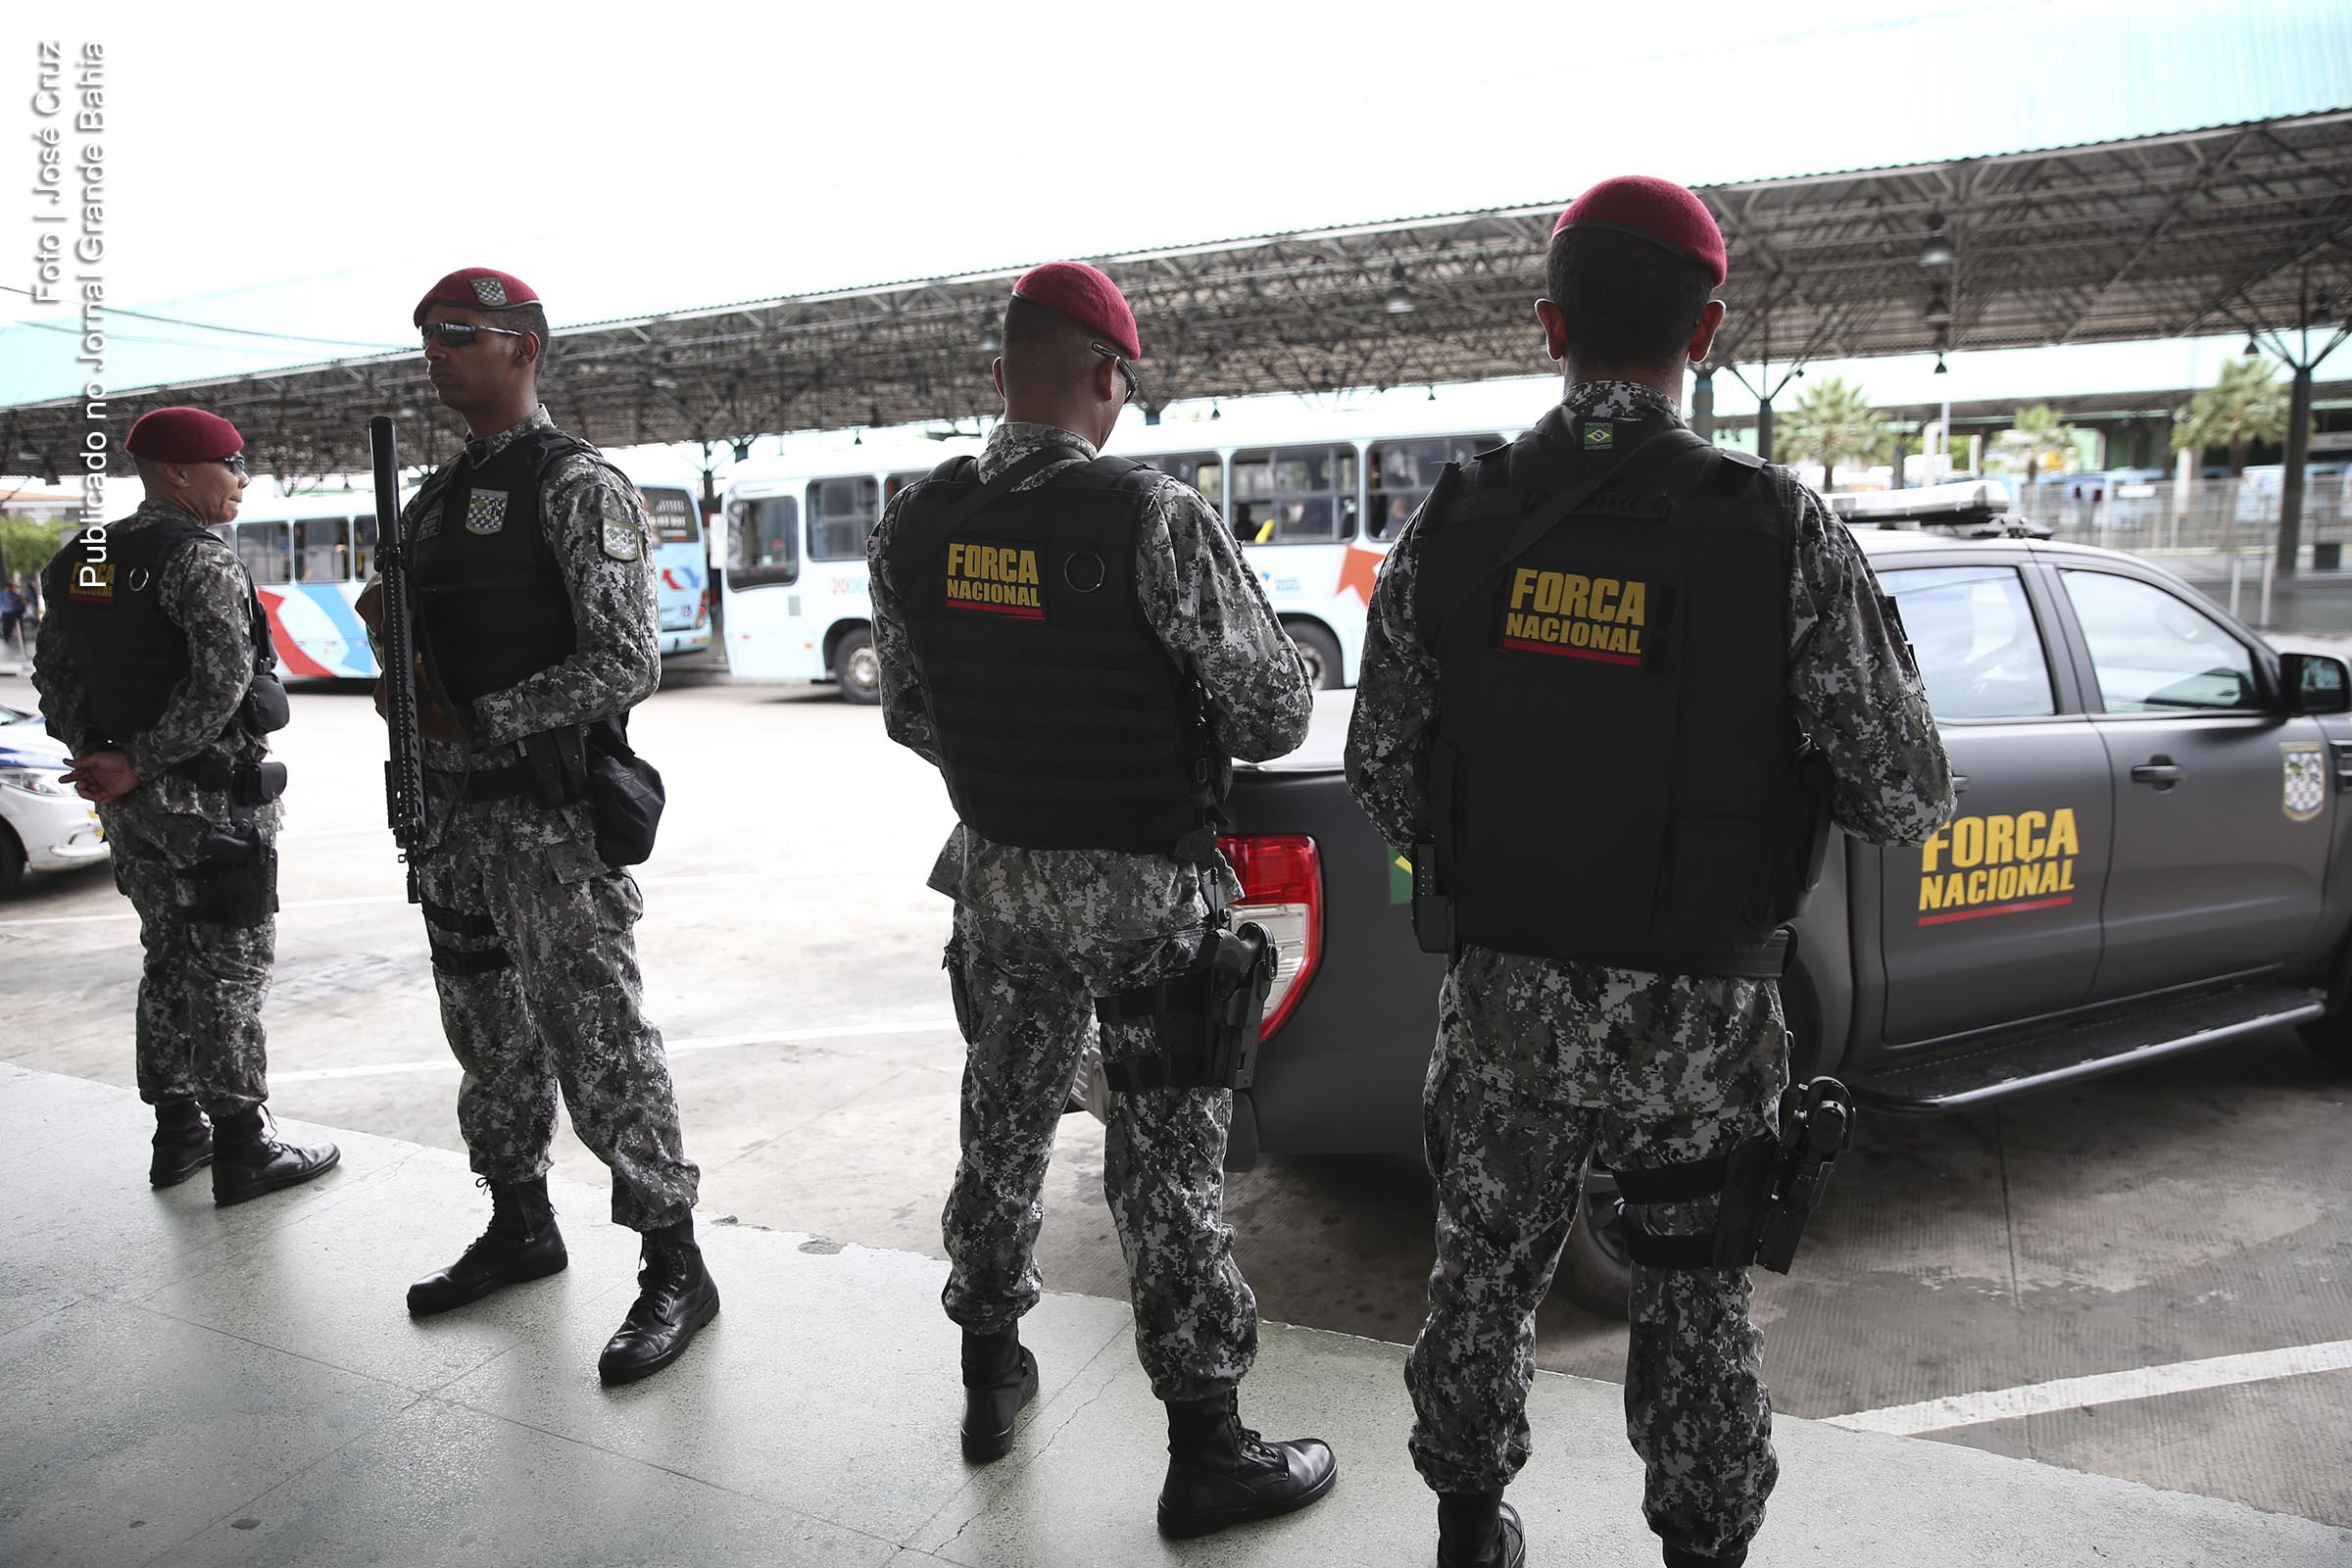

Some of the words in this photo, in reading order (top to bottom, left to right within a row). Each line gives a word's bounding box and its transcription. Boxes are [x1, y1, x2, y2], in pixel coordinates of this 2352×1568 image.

[948, 543, 1040, 585] FORÇA
[947, 578, 1042, 608] NACIONAL
[1510, 567, 1646, 626] FORÇA
[1505, 612, 1642, 655] NACIONAL
[1921, 808, 2080, 873] FORÇA
[1918, 858, 2076, 911] NACIONAL
